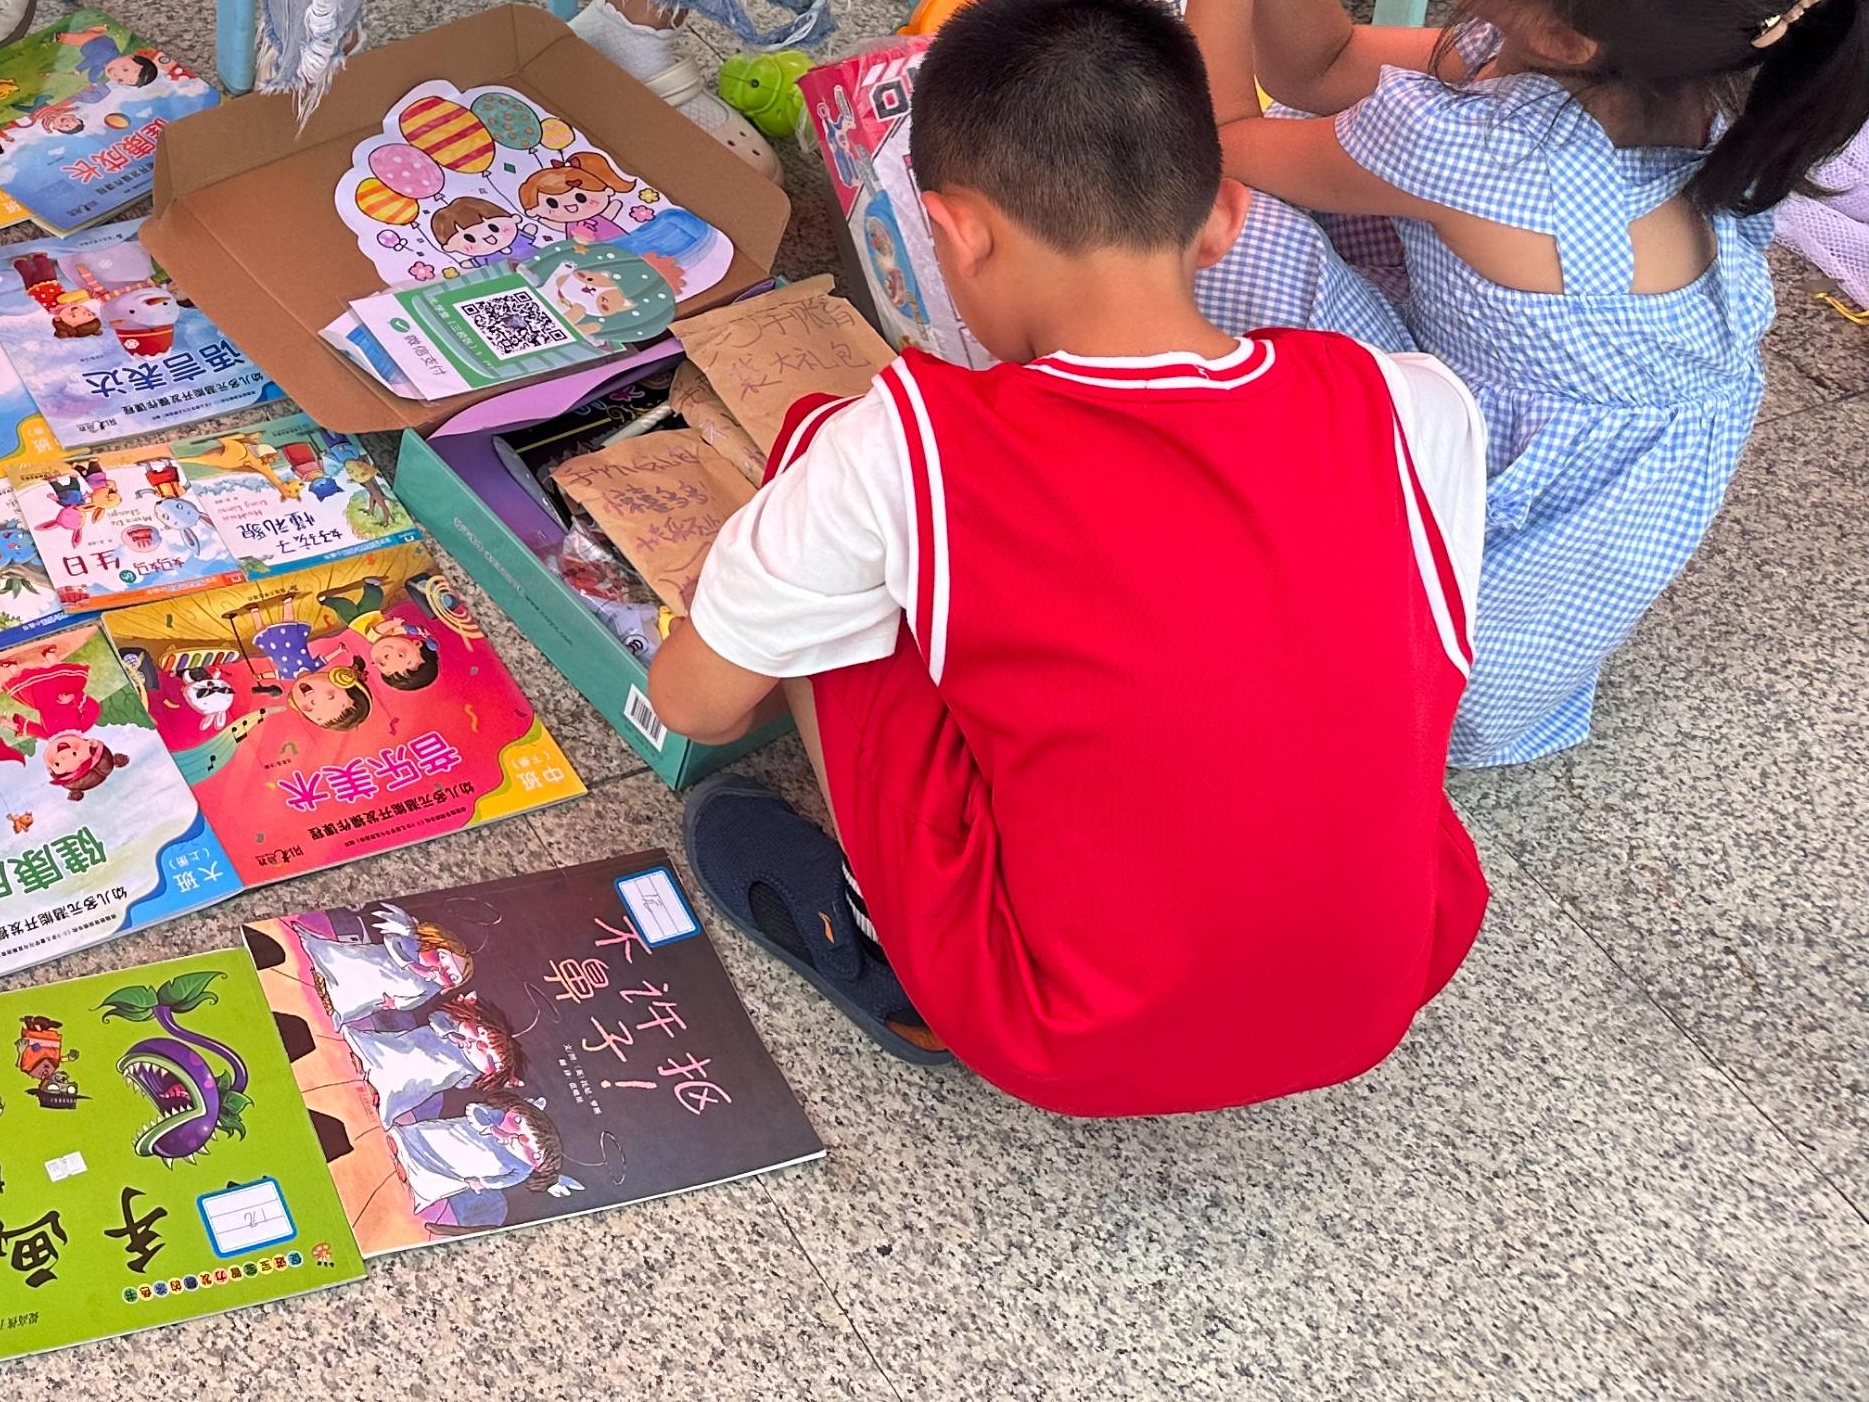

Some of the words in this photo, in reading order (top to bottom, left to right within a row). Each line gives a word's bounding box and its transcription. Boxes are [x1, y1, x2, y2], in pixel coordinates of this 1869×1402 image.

[82, 339, 245, 398] 语言表达
[405, 334, 447, 377] 微信支付
[122, 372, 263, 416] 幼儿多元潜能开发操作课程
[236, 510, 316, 541] 懂礼貌
[275, 528, 342, 554] 好孩子
[279, 731, 461, 811] 音乐美术
[518, 762, 565, 790] 中班
[307, 781, 475, 841] 幼儿多元潜能开发操作课程
[171, 861, 224, 892] 大班
